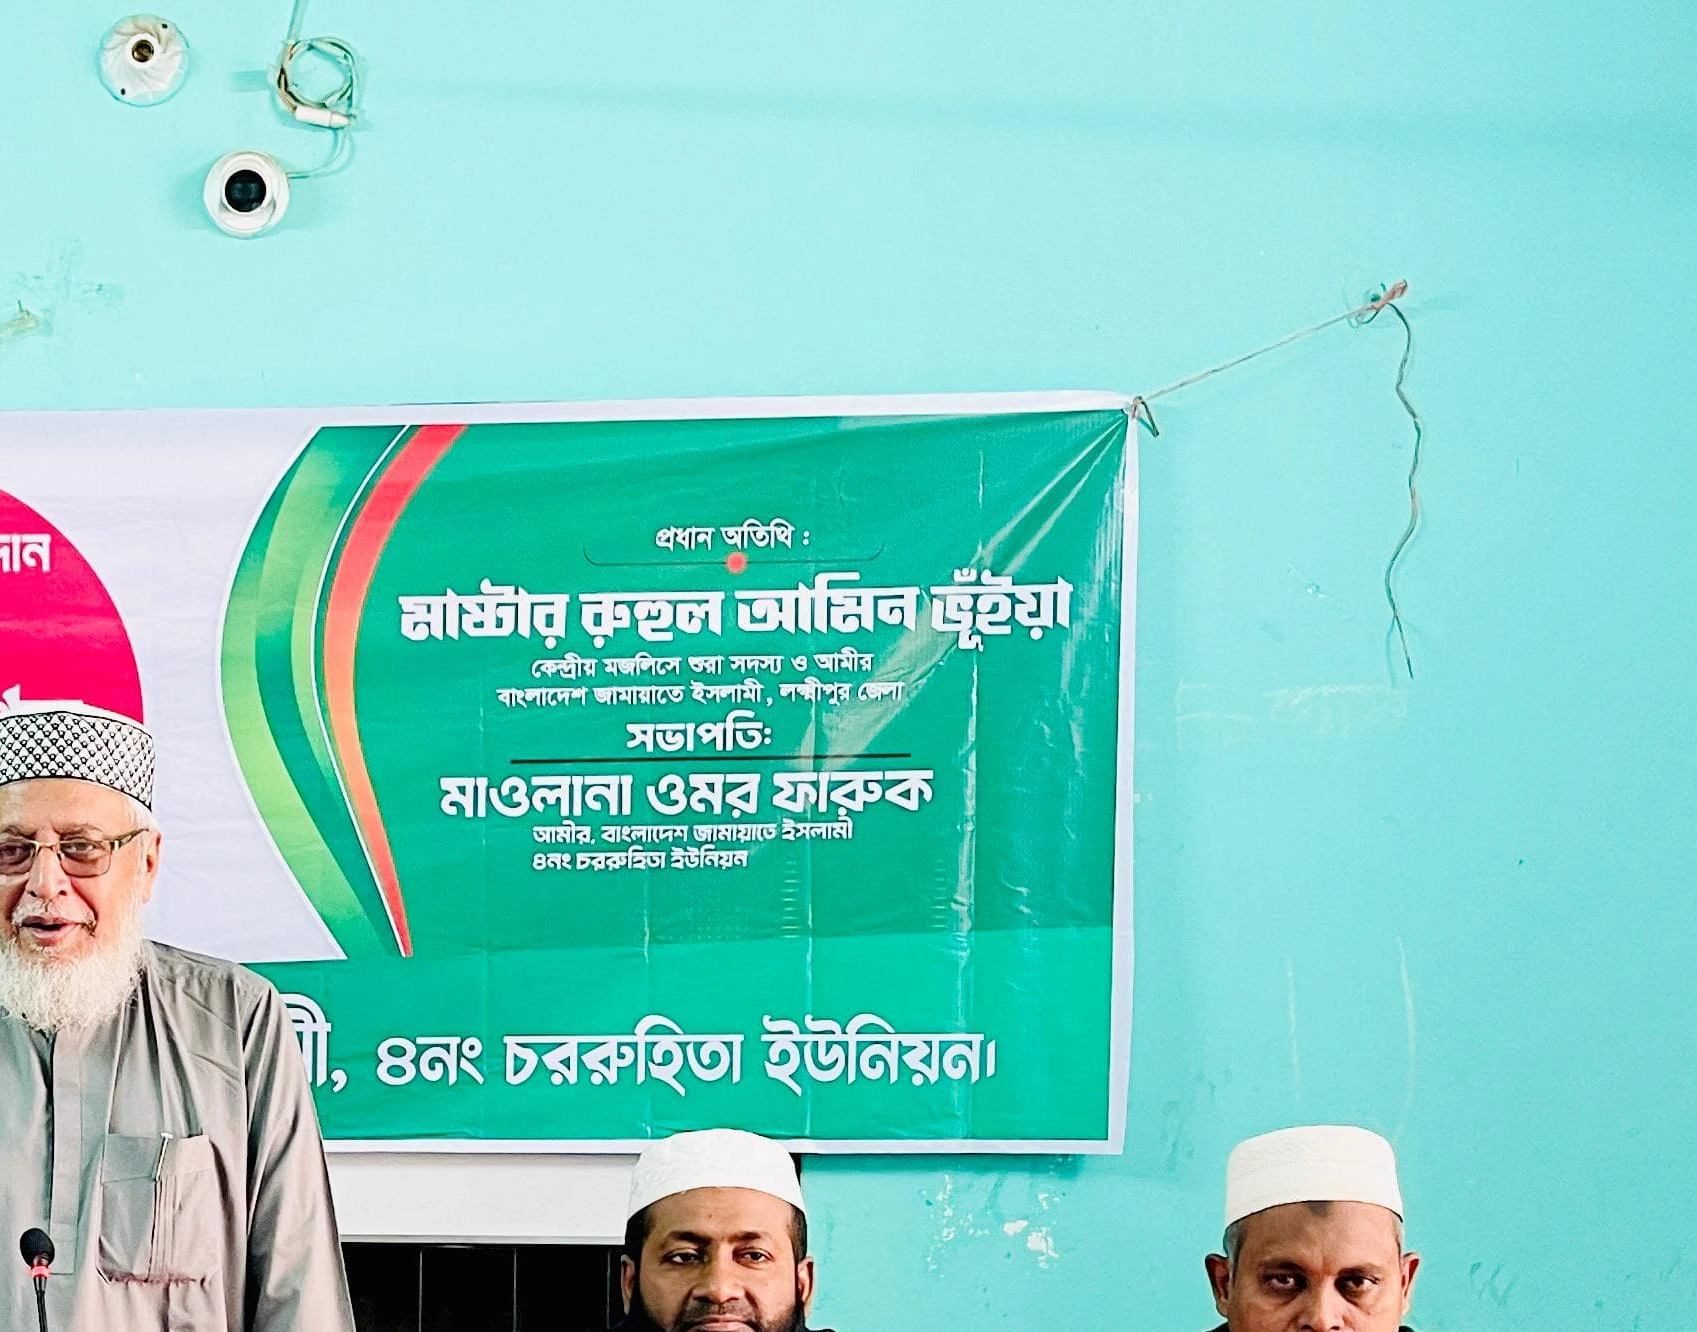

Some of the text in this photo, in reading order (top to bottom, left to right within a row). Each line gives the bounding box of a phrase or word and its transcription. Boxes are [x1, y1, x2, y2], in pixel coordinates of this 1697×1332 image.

[655, 526, 715, 551] প্রধান
[720, 518, 795, 549] অতিথি
[578, 591, 725, 649] রুহুল
[735, 572, 920, 635] আমিন
[531, 652, 598, 679] কেন্দ্রীয়
[603, 651, 682, 676] মজলিসে
[729, 655, 784, 674] সদস্য
[791, 655, 808, 671] ও
[813, 647, 874, 672] আমীর
[496, 686, 588, 707] বাংলাদেশ
[593, 685, 685, 705] জামায়াতে
[857, 681, 906, 701] জেলা
[440, 770, 934, 821] মাওলানা ওমর ফারুক
[601, 825, 689, 843] বাংলাদেশ
[693, 823, 777, 842] জামায়াতে
[782, 813, 853, 841] ইসলামী
[532, 843, 748, 871] ৪নং চররুহিতা ইউনিয়ন
[376, 1036, 484, 1085] ৪নং
[503, 1015, 744, 1096] চররুহিতা
